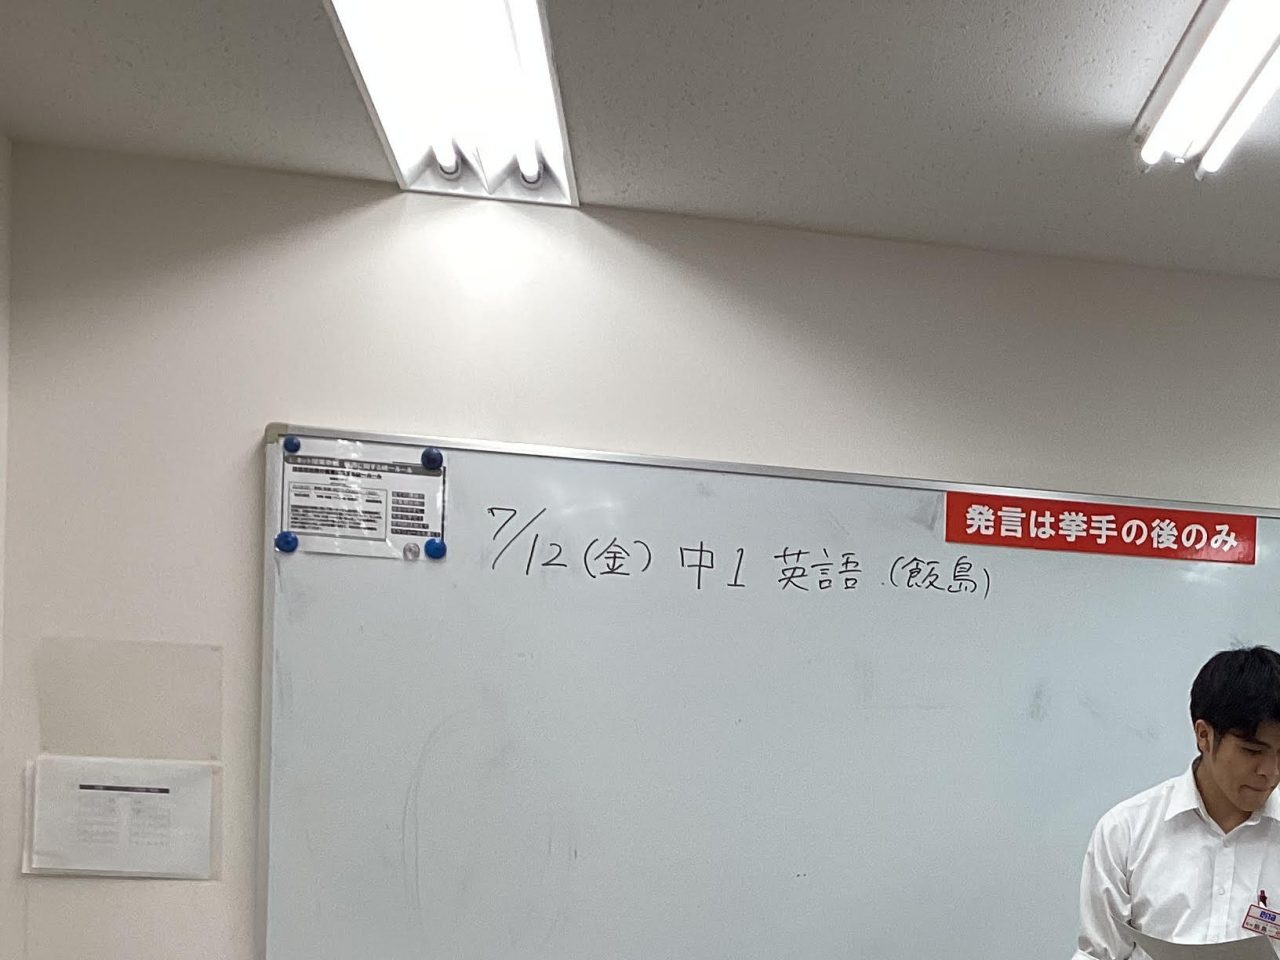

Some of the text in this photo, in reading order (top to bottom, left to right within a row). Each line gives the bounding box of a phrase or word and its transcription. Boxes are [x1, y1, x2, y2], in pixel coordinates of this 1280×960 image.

[965, 503, 1238, 552] 発言は挙手の後のみ
[774, 546, 863, 592] 英語
